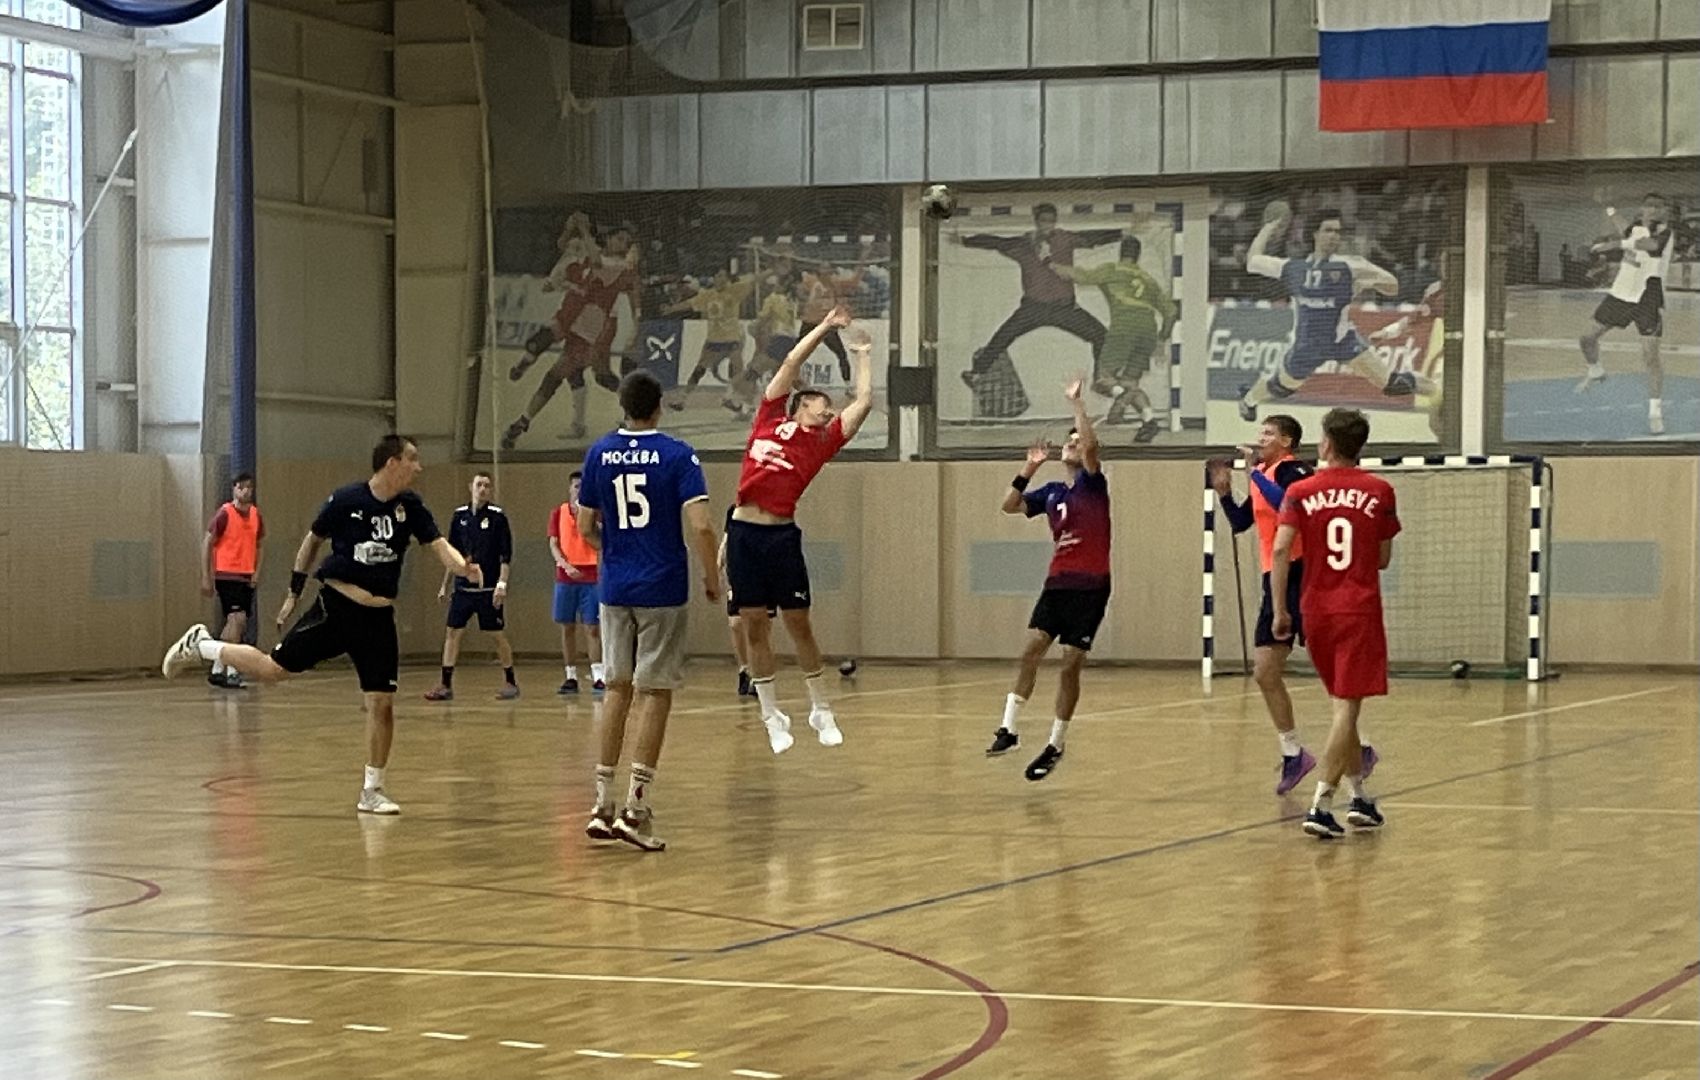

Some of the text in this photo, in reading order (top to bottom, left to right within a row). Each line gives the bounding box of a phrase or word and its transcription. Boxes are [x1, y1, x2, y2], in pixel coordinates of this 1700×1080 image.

[1206, 329, 1289, 381] Energ
[602, 450, 660, 466] МОСКВА
[612, 473, 650, 530] 15
[1057, 502, 1068, 521] 7
[371, 514, 394, 541] 30
[1327, 516, 1353, 571] 9
